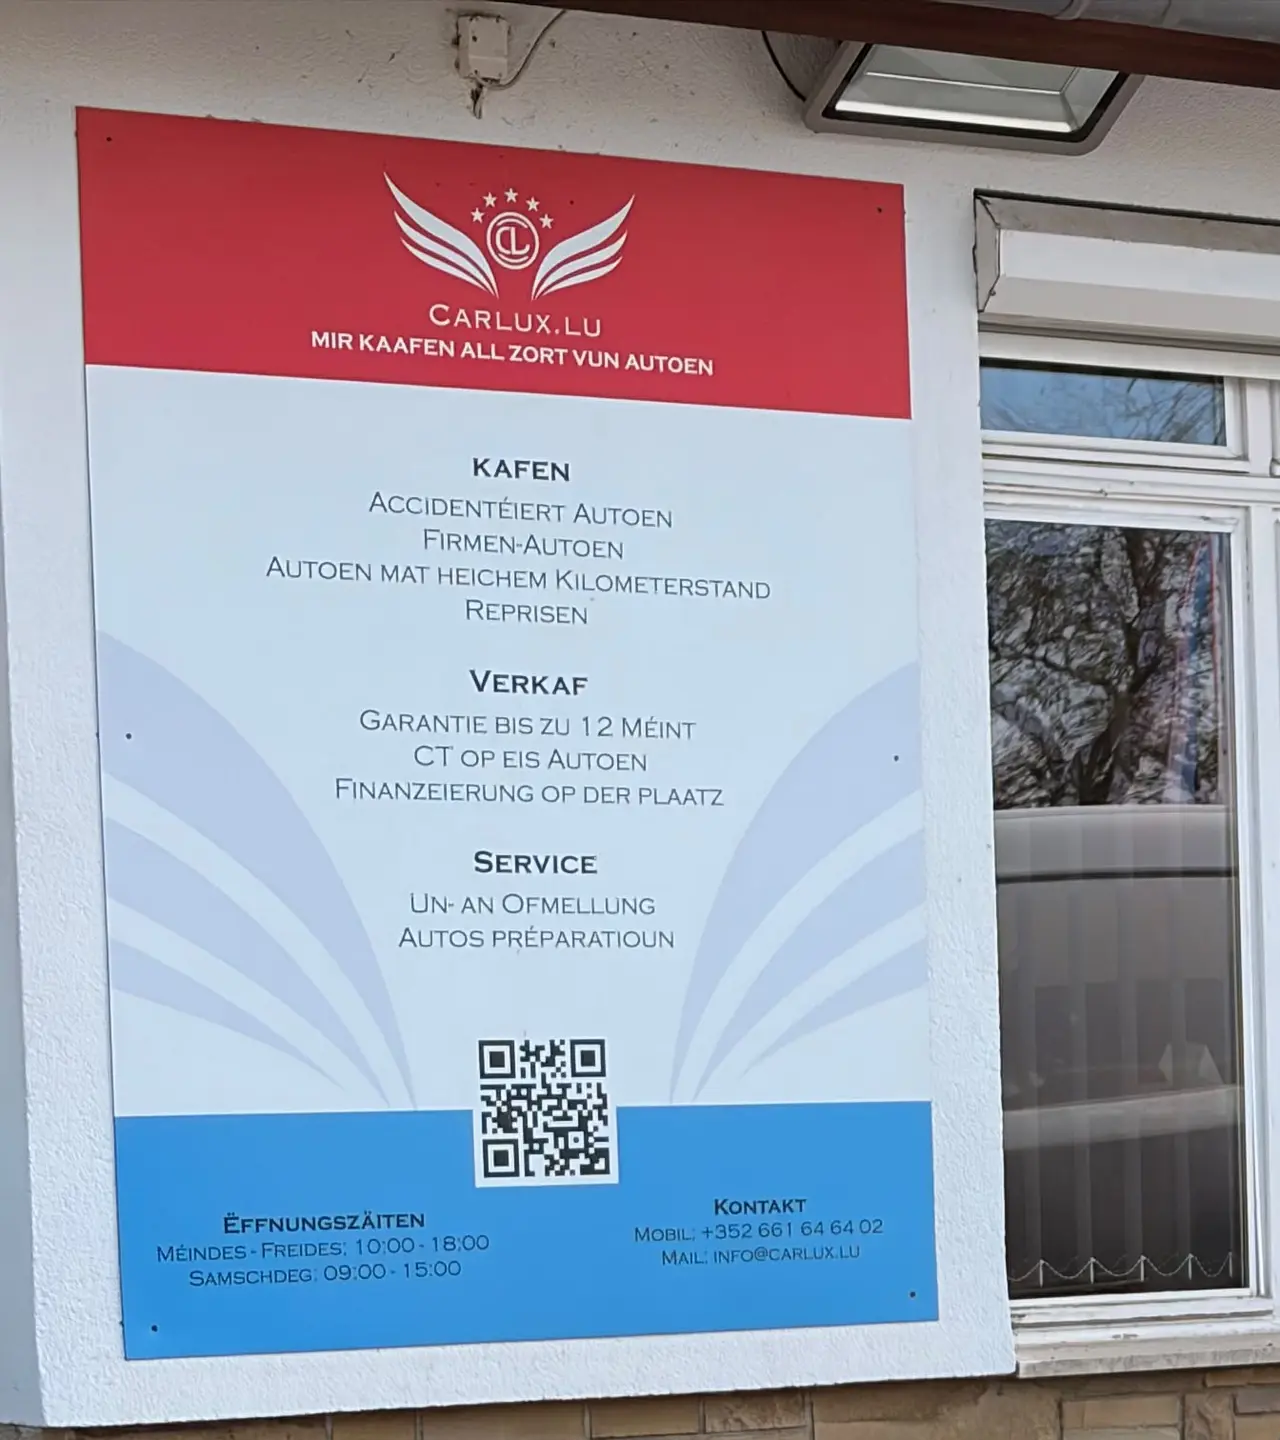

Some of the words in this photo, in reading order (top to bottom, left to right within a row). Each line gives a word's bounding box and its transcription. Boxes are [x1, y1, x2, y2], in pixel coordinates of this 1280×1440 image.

[429, 303, 601, 338] CARLUX.LU
[311, 330, 353, 350] MIR
[359, 333, 455, 358] KAAFEN
[460, 341, 505, 361] ALL
[508, 344, 569, 366] ZORT
[571, 349, 620, 369] VUN
[624, 353, 714, 376] AUTOEN
[472, 457, 570, 482] KAFEN
[368, 491, 566, 523] ACCIDENTÉIERT
[572, 502, 672, 529] AUTOEN
[423, 528, 623, 560] FIRMEN-AUTOEN
[265, 555, 372, 582] AUTOEN
[380, 564, 430, 585] MAT
[437, 566, 547, 590] HEICHEM
[555, 568, 771, 599] KILOMETERSTAND
[465, 599, 588, 625] REPRISEN
[469, 669, 589, 696] VERKAF
[359, 709, 488, 735] GARANTIE
[495, 716, 534, 735] BIS
[539, 717, 570, 736] ZU
[582, 715, 614, 737] 12
[621, 715, 697, 740] MÉINT
[413, 745, 454, 767] CT
[460, 749, 496, 768] OP
[503, 750, 540, 769] EIS
[547, 748, 647, 772] AUTOEN
[335, 777, 534, 803] FINANZEIERUNG
[541, 785, 576, 803] OP
[583, 786, 631, 805] DER
[638, 787, 725, 807] PLAATZ
[474, 850, 598, 875] SERVICE
[410, 892, 455, 914] UN-
[460, 896, 494, 915] AN
[502, 893, 656, 915] OFMELLUNG
[398, 926, 485, 949] AUTOS
[492, 925, 674, 949] PRÉPARATIOUN
[714, 1198, 807, 1216] KONTAKT
[223, 1210, 425, 1235] ËFFNUNGSZÄITEN
[701, 1222, 753, 1240] +352
[757, 1221, 792, 1238] 661
[800, 1221, 824, 1237] 64
[830, 1219, 854, 1236] 64
[858, 1218, 883, 1235] 02
[156, 1243, 247, 1263] MÉINDES
[355, 1236, 415, 1256] 10:00
[432, 1234, 490, 1253] 18:00
[713, 1245, 860, 1264] INFO@CARLUX.LU
[323, 1263, 387, 1281] 09:00
[403, 1260, 462, 1279] 15:00
